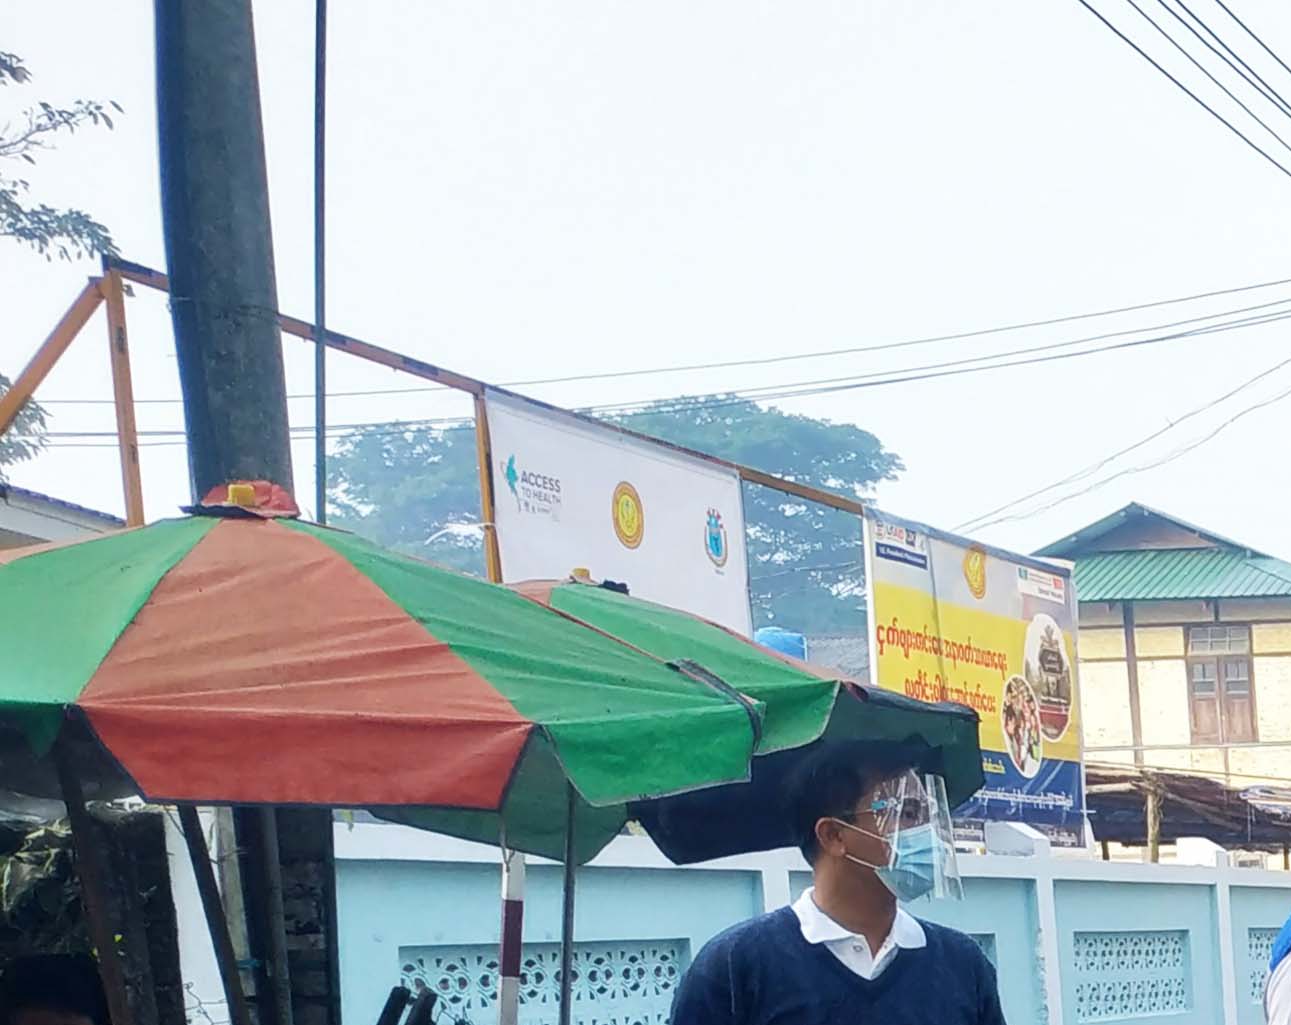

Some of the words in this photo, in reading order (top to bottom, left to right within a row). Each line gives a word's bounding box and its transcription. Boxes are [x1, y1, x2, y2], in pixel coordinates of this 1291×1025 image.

[521, 470, 561, 493] ACCESS
[521, 486, 532, 499] TO
[533, 488, 561, 504] HEALTH
